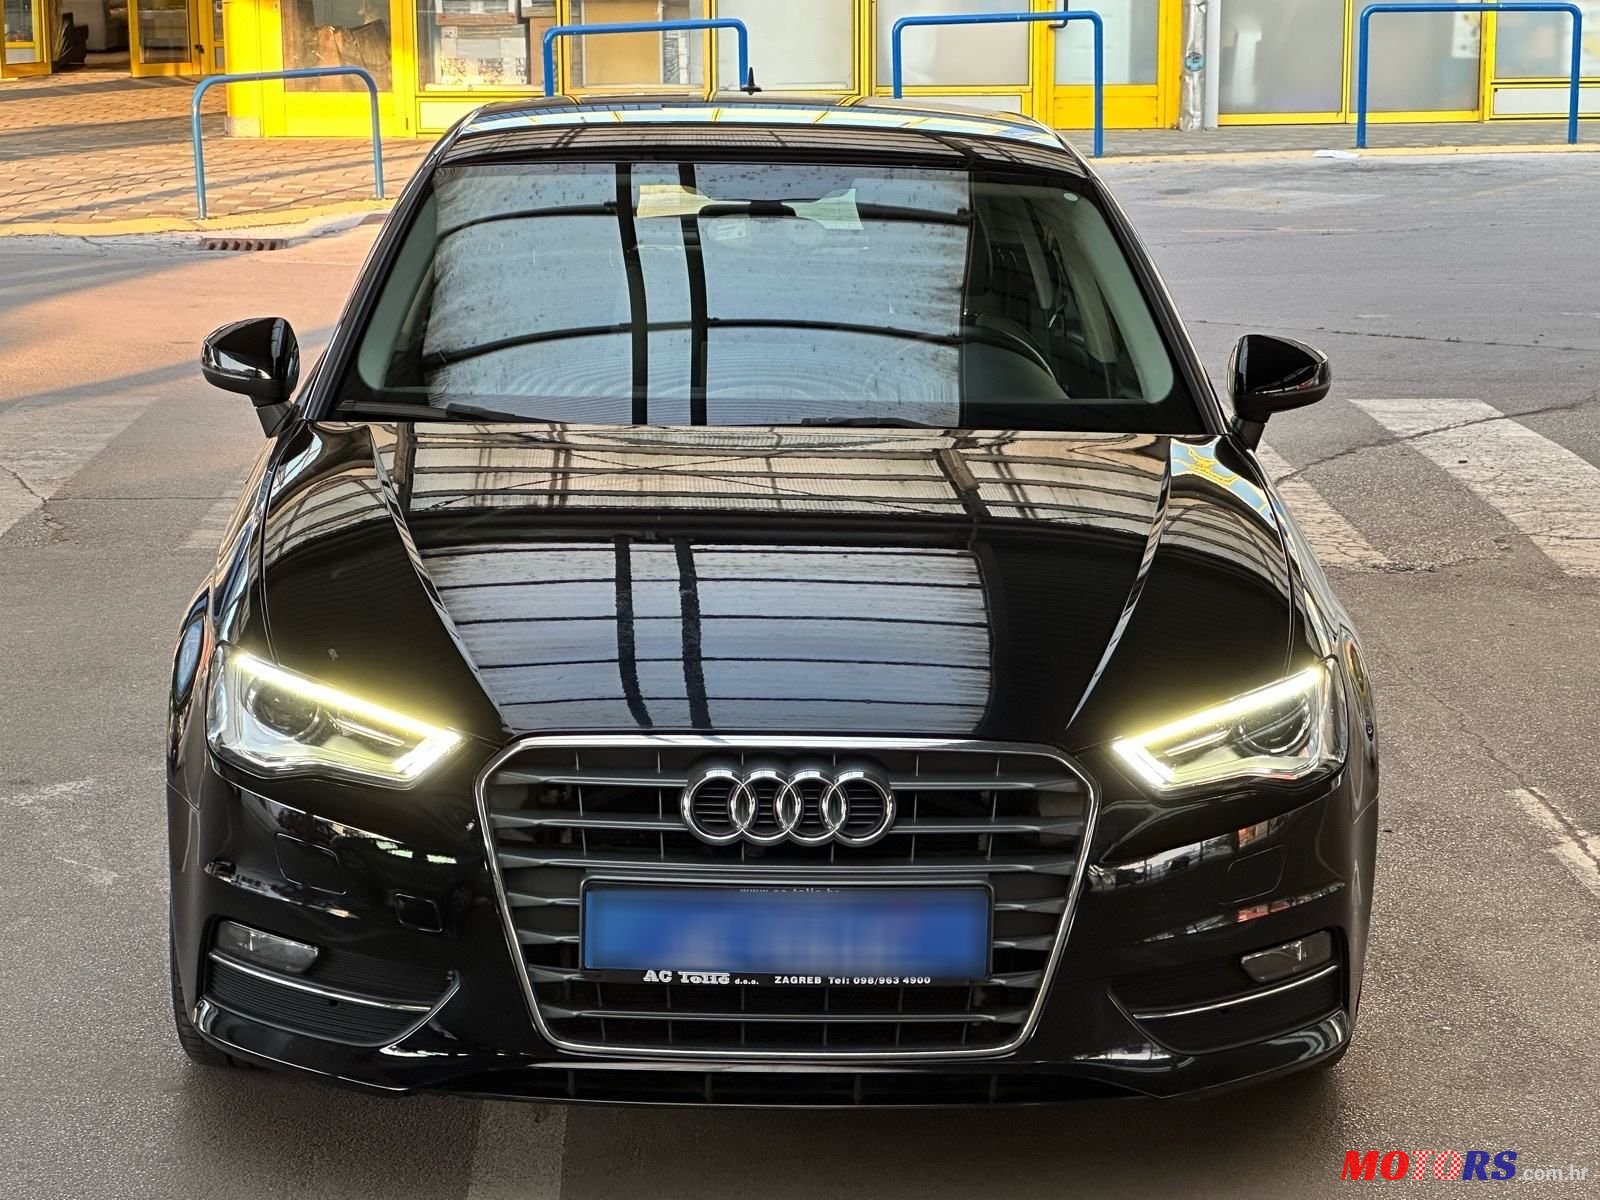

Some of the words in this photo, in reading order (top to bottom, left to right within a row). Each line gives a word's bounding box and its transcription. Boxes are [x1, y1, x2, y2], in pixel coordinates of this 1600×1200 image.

[643, 970, 673, 983] AC
[774, 975, 822, 985] ZAGREB
[828, 976, 850, 985] Tel:
[853, 976, 899, 986] 098/963
[902, 976, 931, 985] 4900
